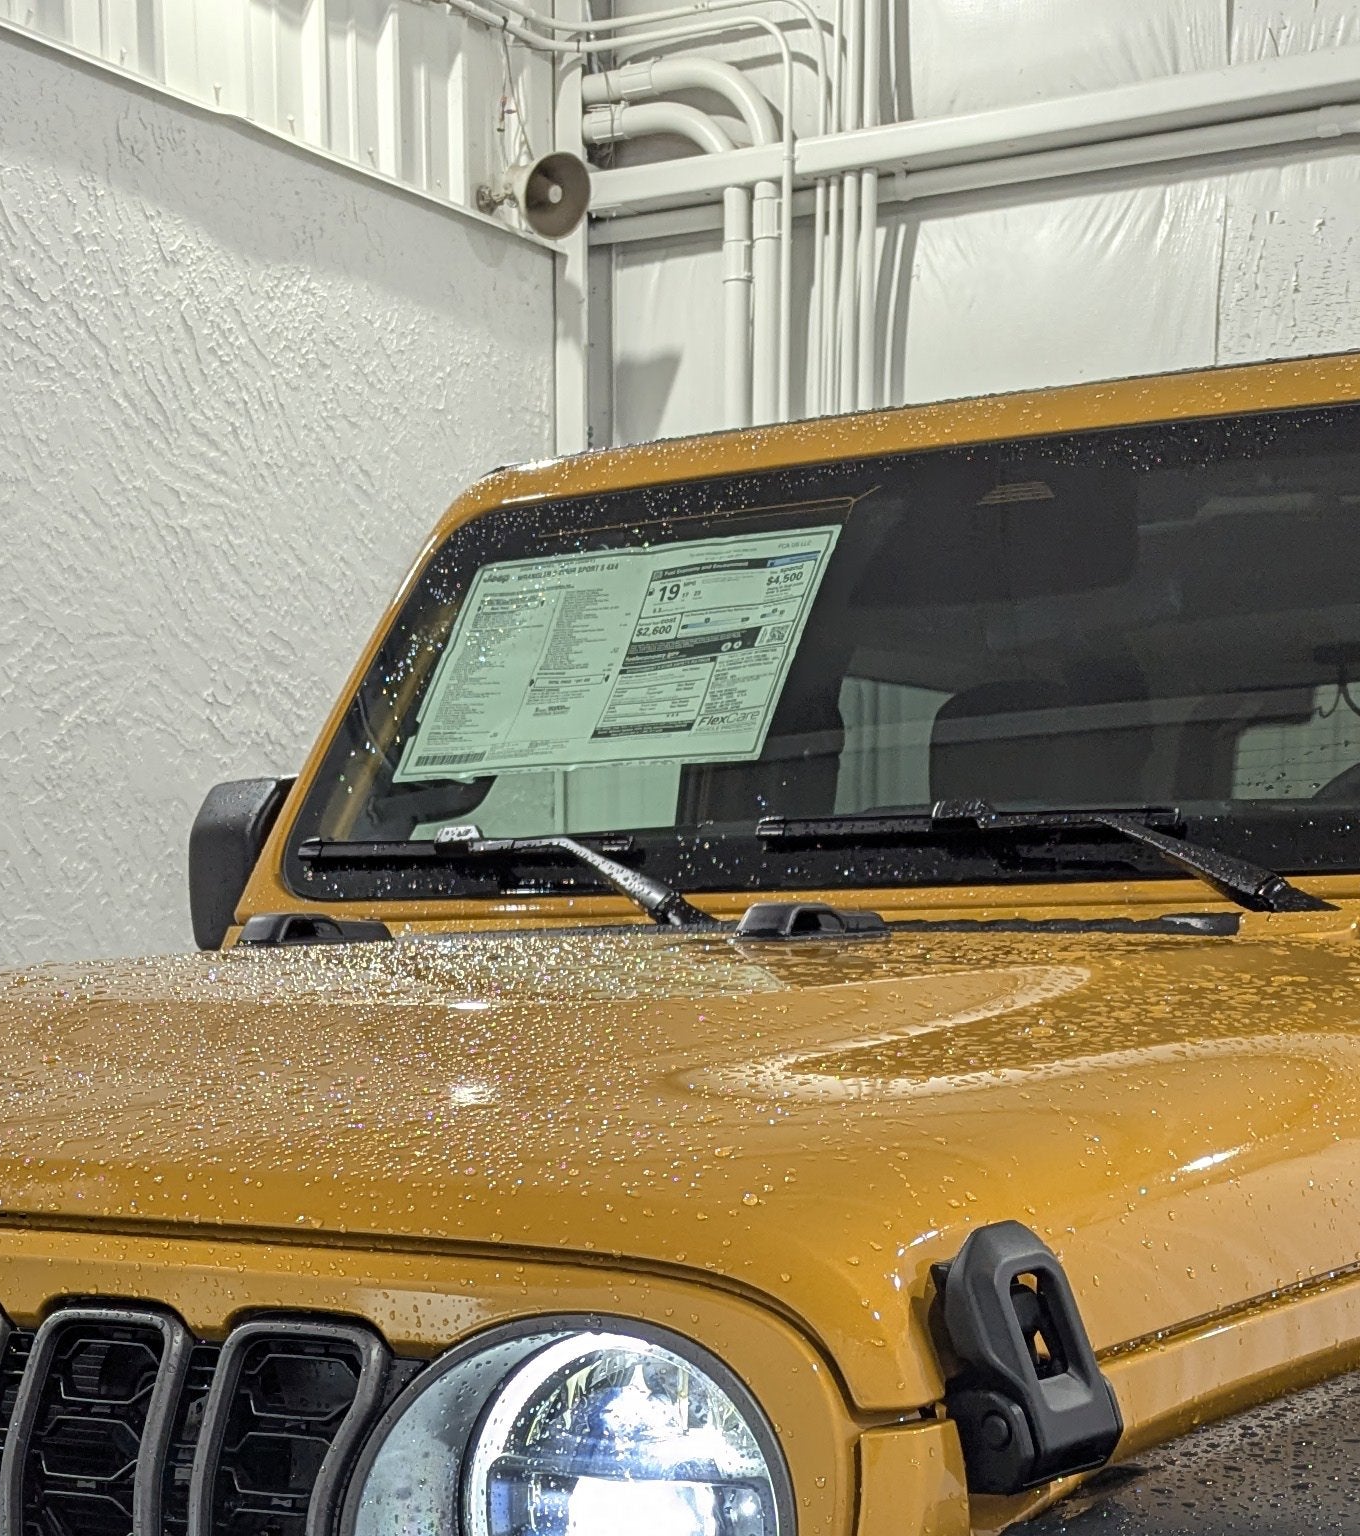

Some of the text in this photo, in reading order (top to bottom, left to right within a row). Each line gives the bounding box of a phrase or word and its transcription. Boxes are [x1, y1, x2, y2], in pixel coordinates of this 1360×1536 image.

[578, 565, 600, 574] SPORT
[766, 571, 803, 587] $4,500
[658, 583, 680, 602] 19
[636, 625, 672, 637] $2,600
[697, 710, 761, 727] FlexCare
